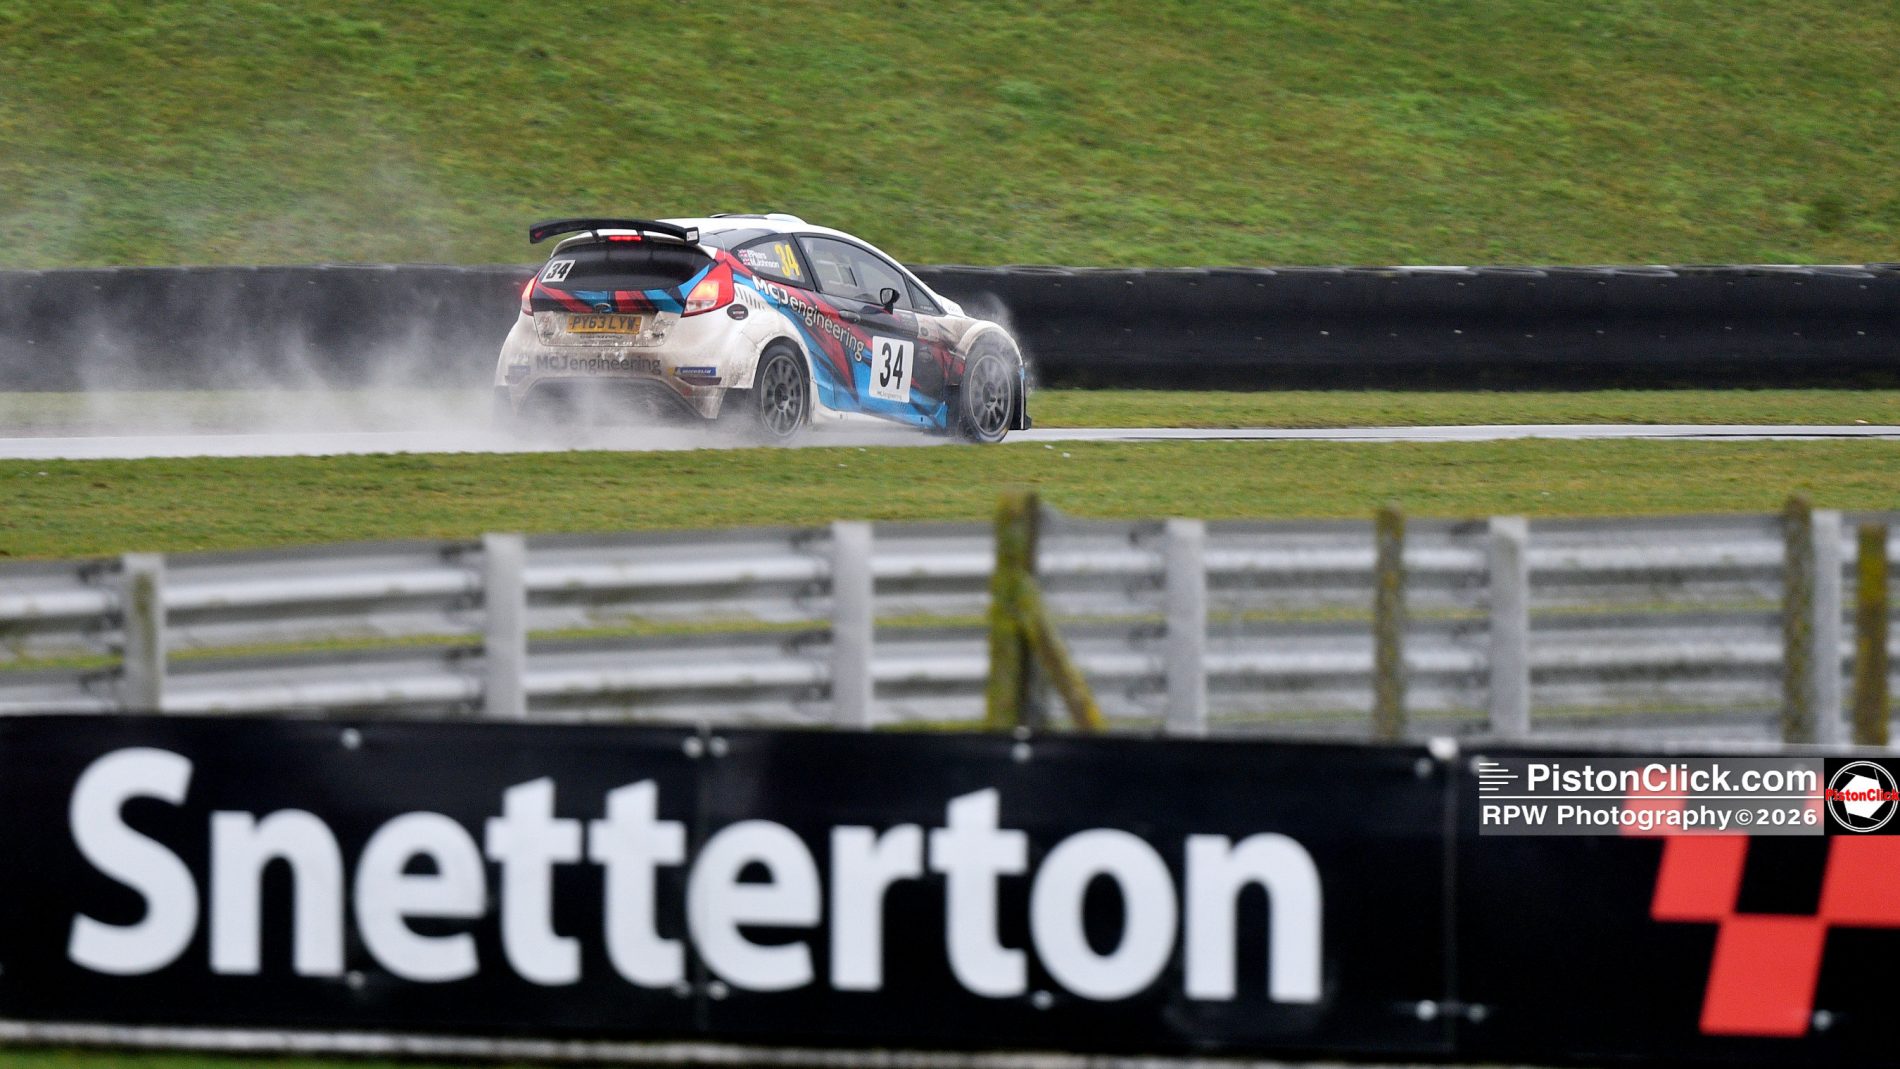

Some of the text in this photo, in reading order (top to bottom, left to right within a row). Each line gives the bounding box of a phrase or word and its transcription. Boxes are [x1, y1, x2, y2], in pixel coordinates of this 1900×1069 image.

[545, 262, 572, 279] 34
[775, 243, 800, 277] 34
[571, 315, 636, 330] PY63 LYW
[879, 342, 904, 390] 34
[69, 747, 1323, 1002] Snetterton
